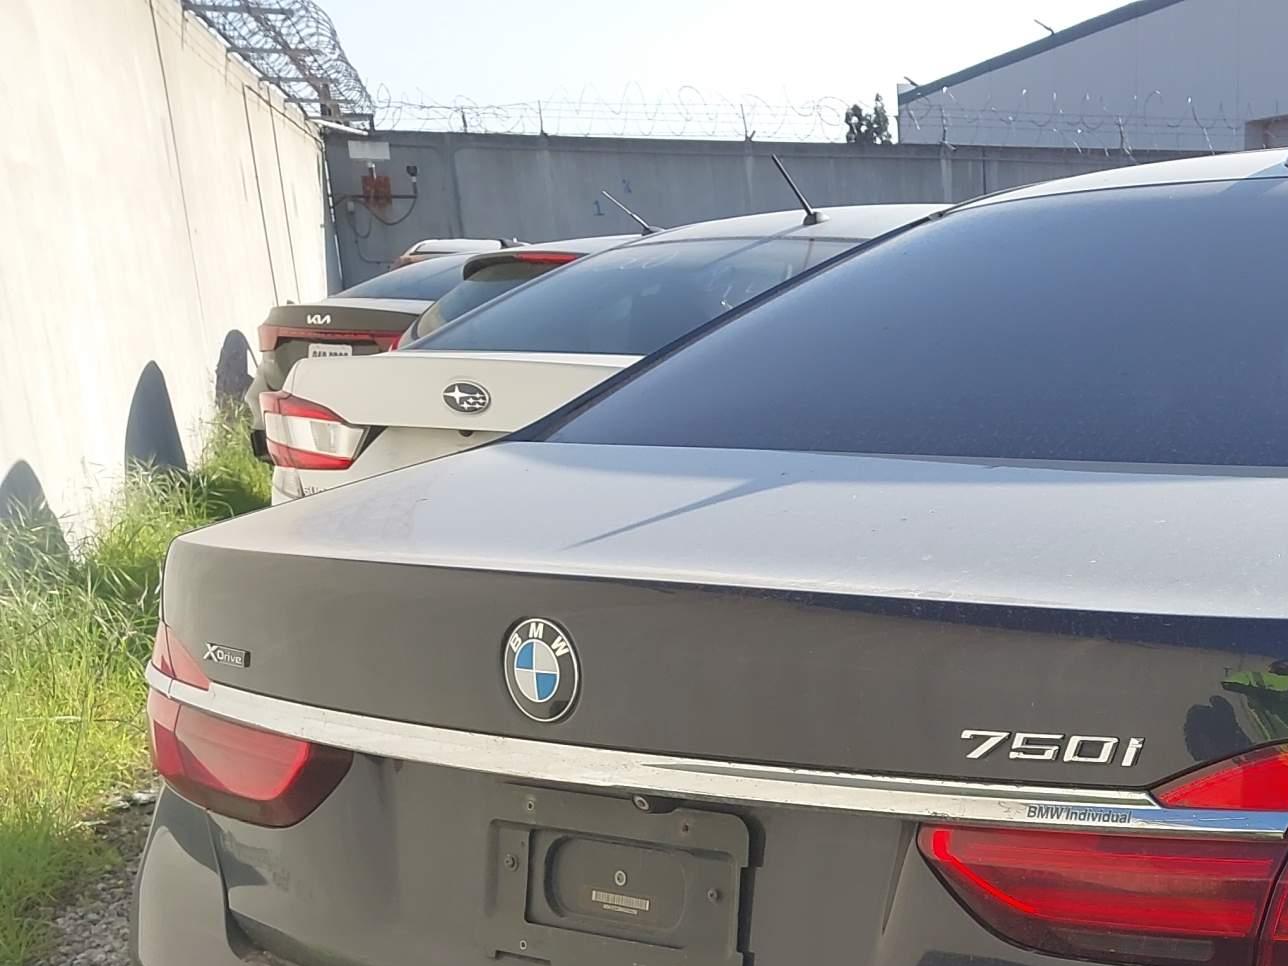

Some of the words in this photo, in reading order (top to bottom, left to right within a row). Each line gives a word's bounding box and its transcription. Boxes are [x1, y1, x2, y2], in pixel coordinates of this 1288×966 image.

[307, 314, 331, 325] KIA
[509, 622, 569, 656] BMW
[960, 729, 1146, 767] 750i
[1027, 805, 1064, 820] BMW
[1065, 809, 1132, 824] Individual
